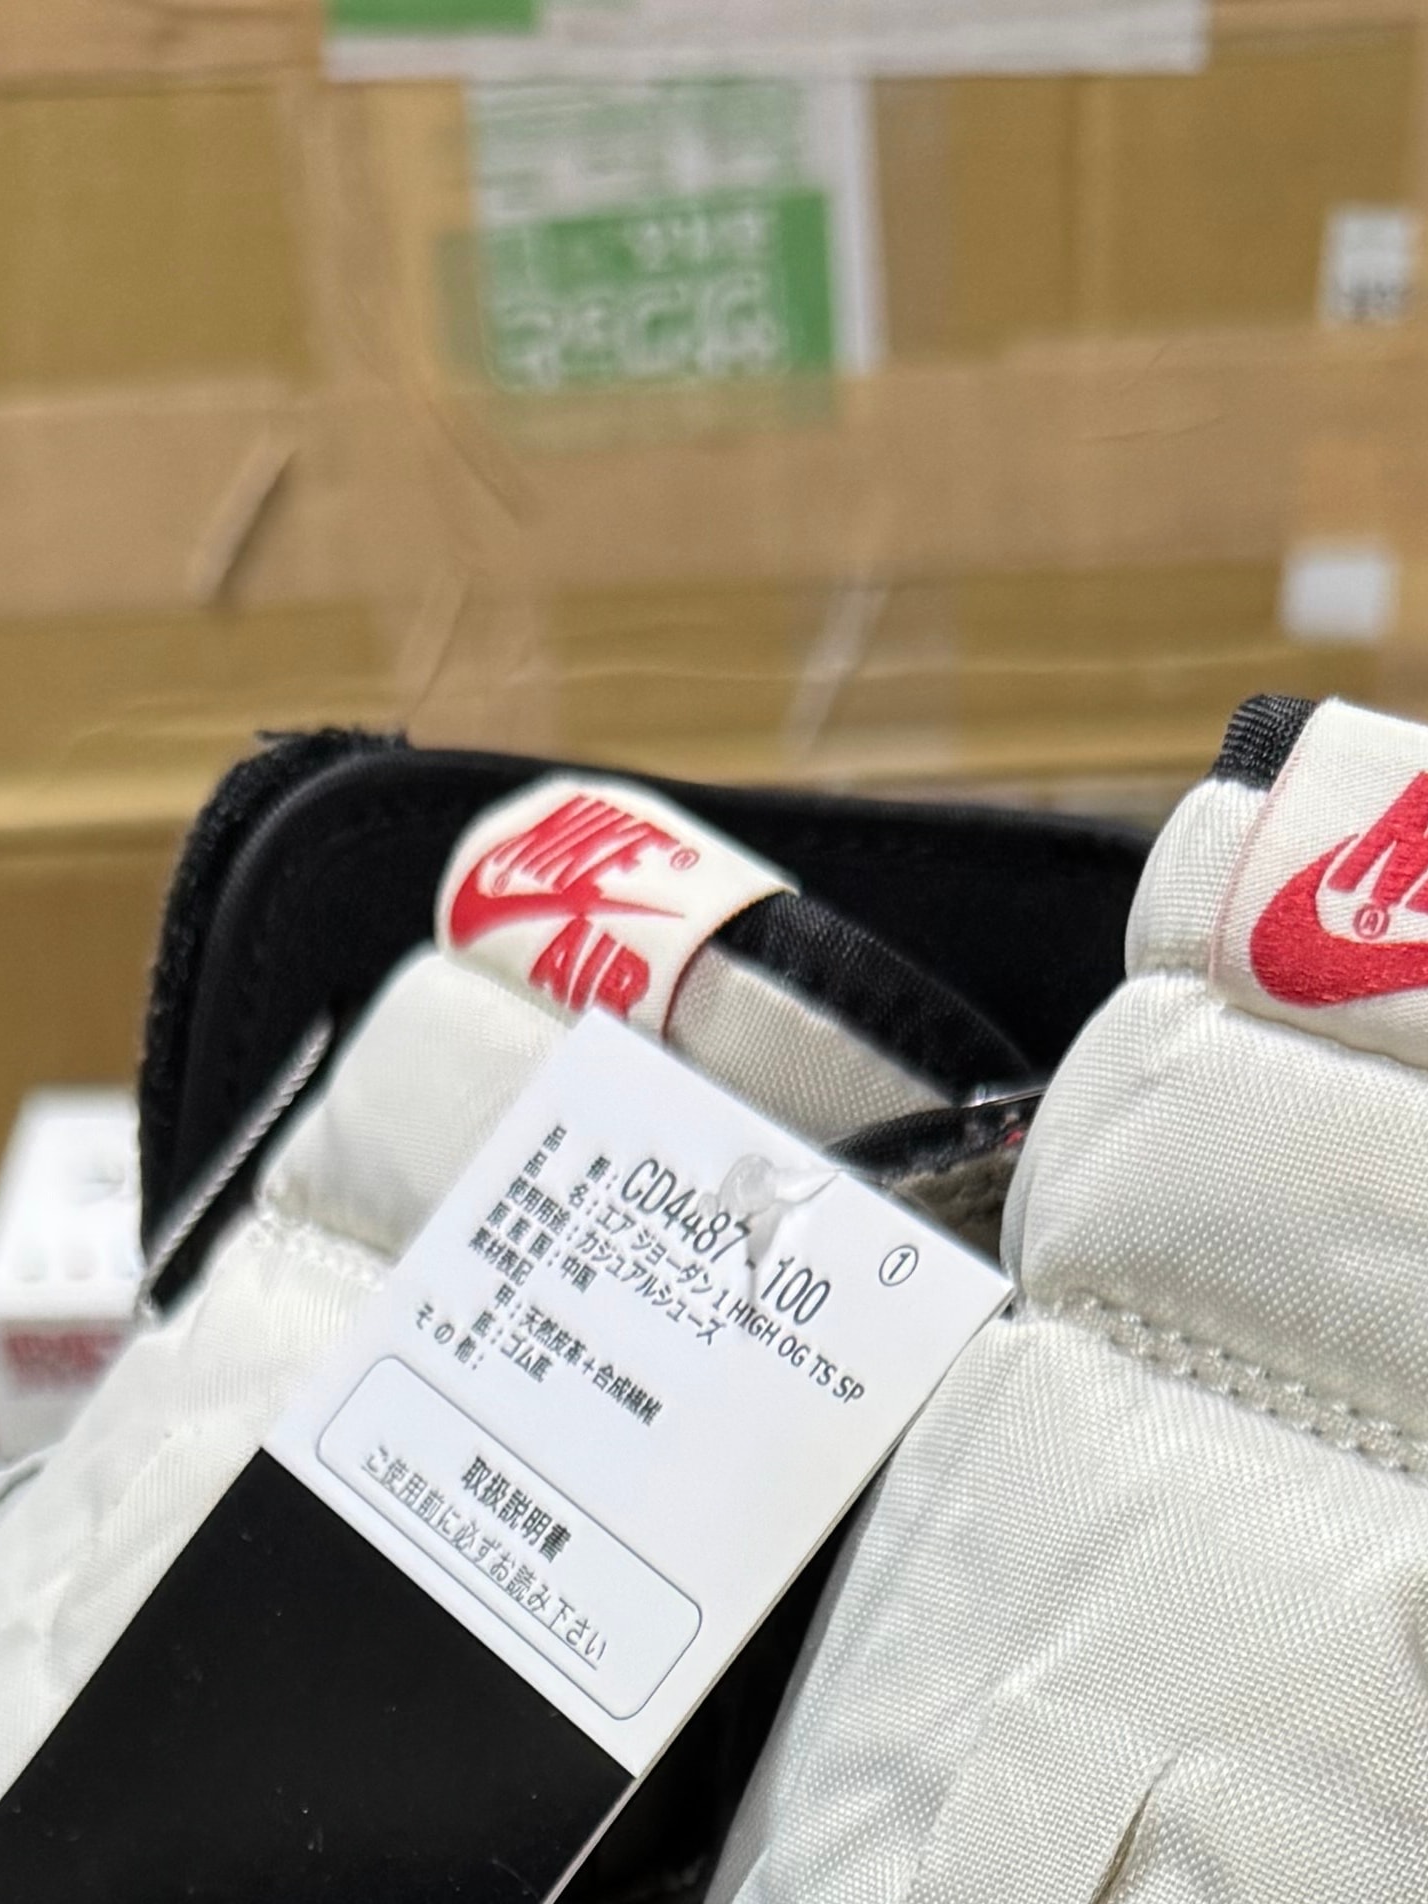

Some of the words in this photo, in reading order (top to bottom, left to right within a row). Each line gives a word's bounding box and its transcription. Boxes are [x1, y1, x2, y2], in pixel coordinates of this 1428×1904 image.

[494, 796, 681, 897] NIKE
[529, 916, 650, 1020] AIR
[727, 1298, 779, 1346] HIGH
[778, 1336, 810, 1367] OG
[809, 1355, 838, 1386] TS
[833, 1376, 864, 1404] SP
[461, 1456, 571, 1563] 取扱説明書
